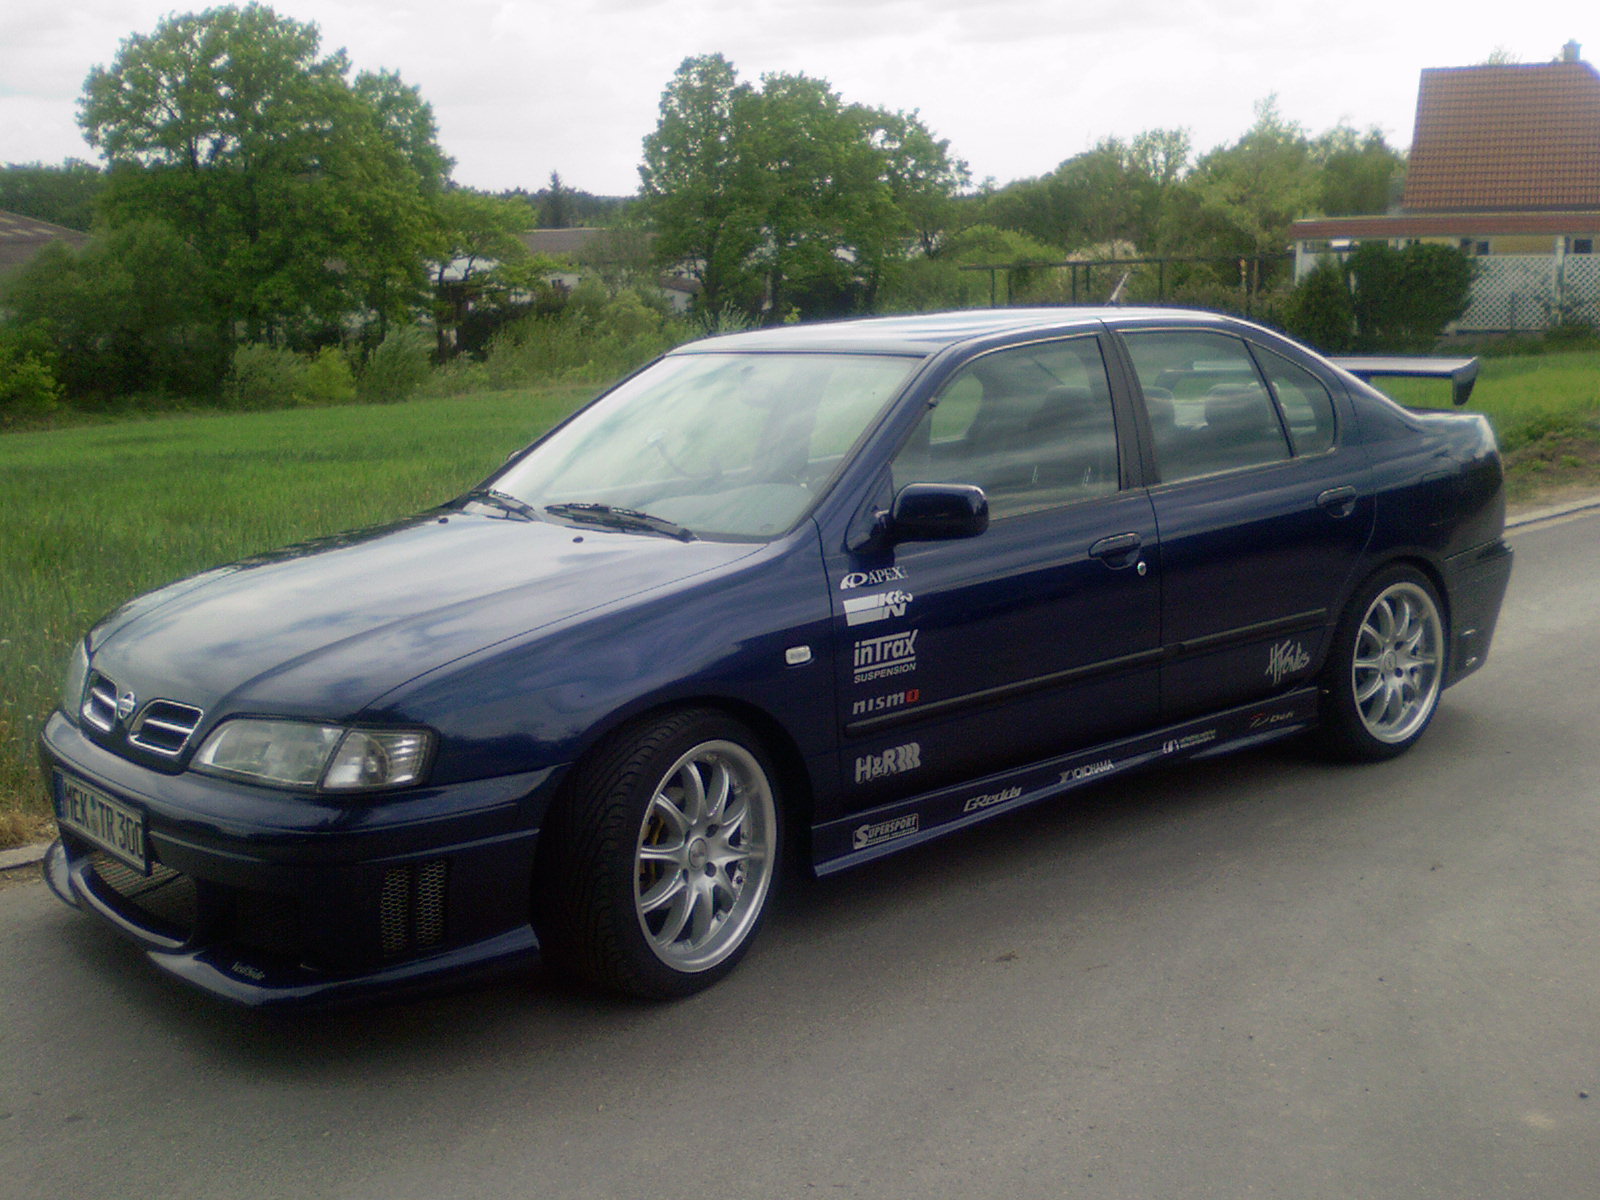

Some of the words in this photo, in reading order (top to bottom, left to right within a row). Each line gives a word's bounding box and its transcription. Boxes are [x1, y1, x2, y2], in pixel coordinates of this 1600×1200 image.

[854, 629, 918, 666] inTrax
[854, 662, 917, 684] SUSPENSION
[853, 689, 919, 715] nismo
[855, 748, 897, 784] H&R
[99, 800, 116, 845] TR
[117, 811, 144, 859] 300
